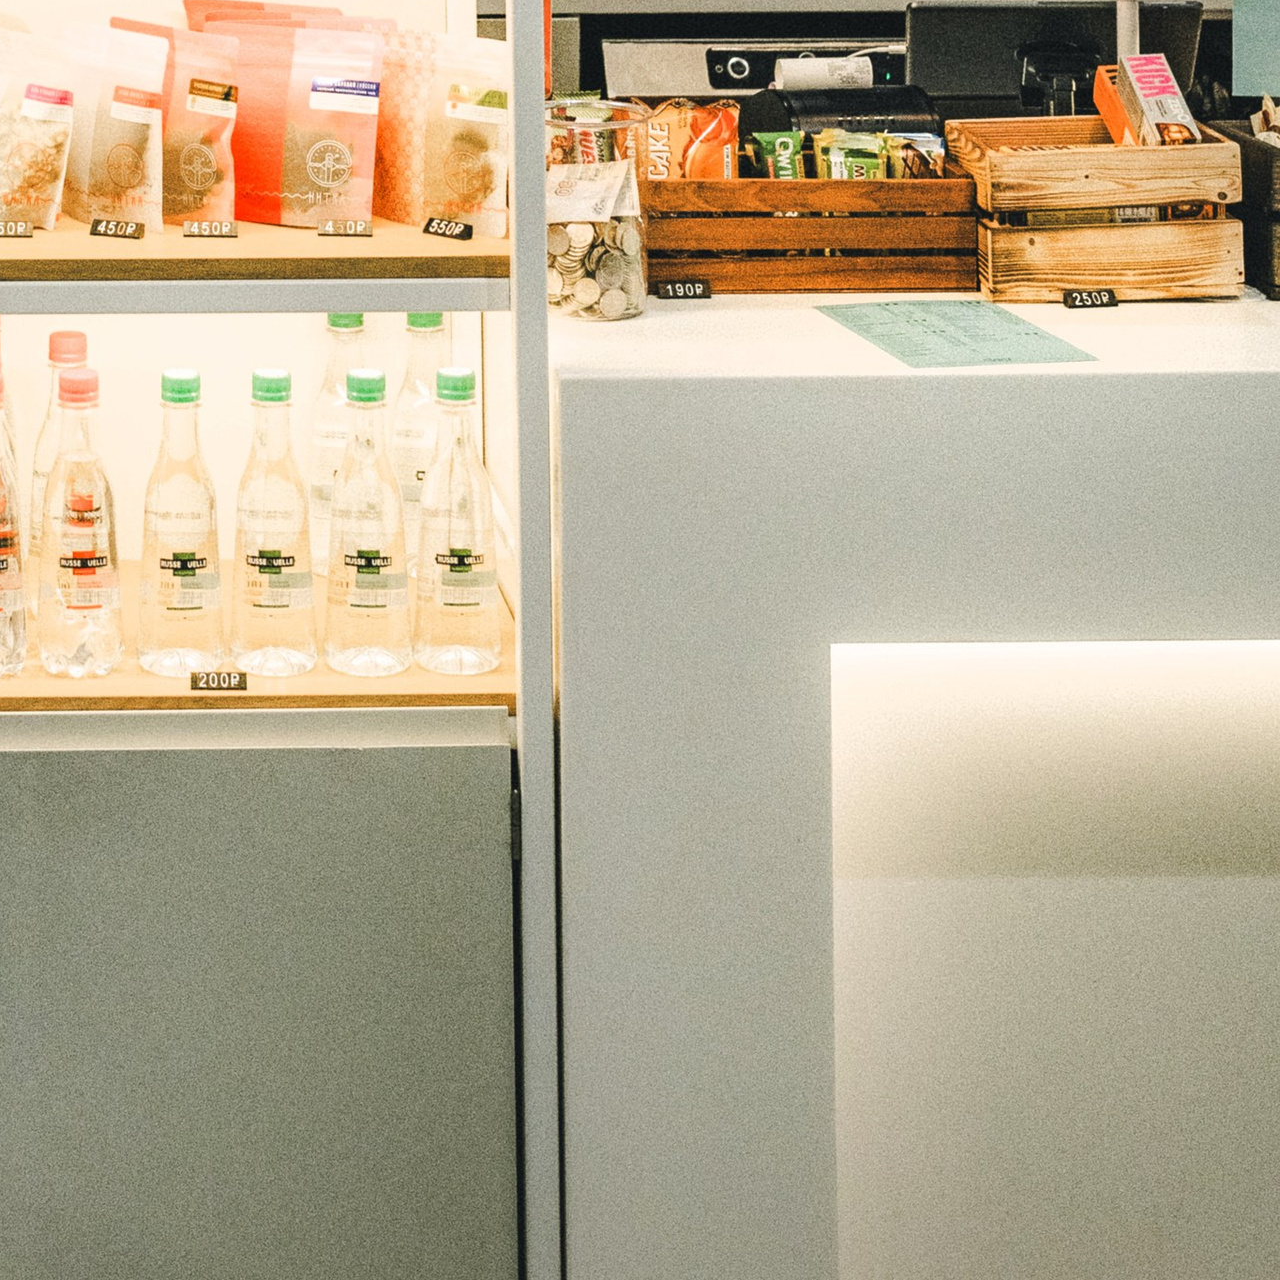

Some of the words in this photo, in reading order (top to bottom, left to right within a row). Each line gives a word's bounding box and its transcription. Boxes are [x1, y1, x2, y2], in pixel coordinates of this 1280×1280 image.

[1126, 55, 1179, 99] KICK
[1170, 100, 1191, 122] ZERO
[648, 122, 671, 180] CAKE
